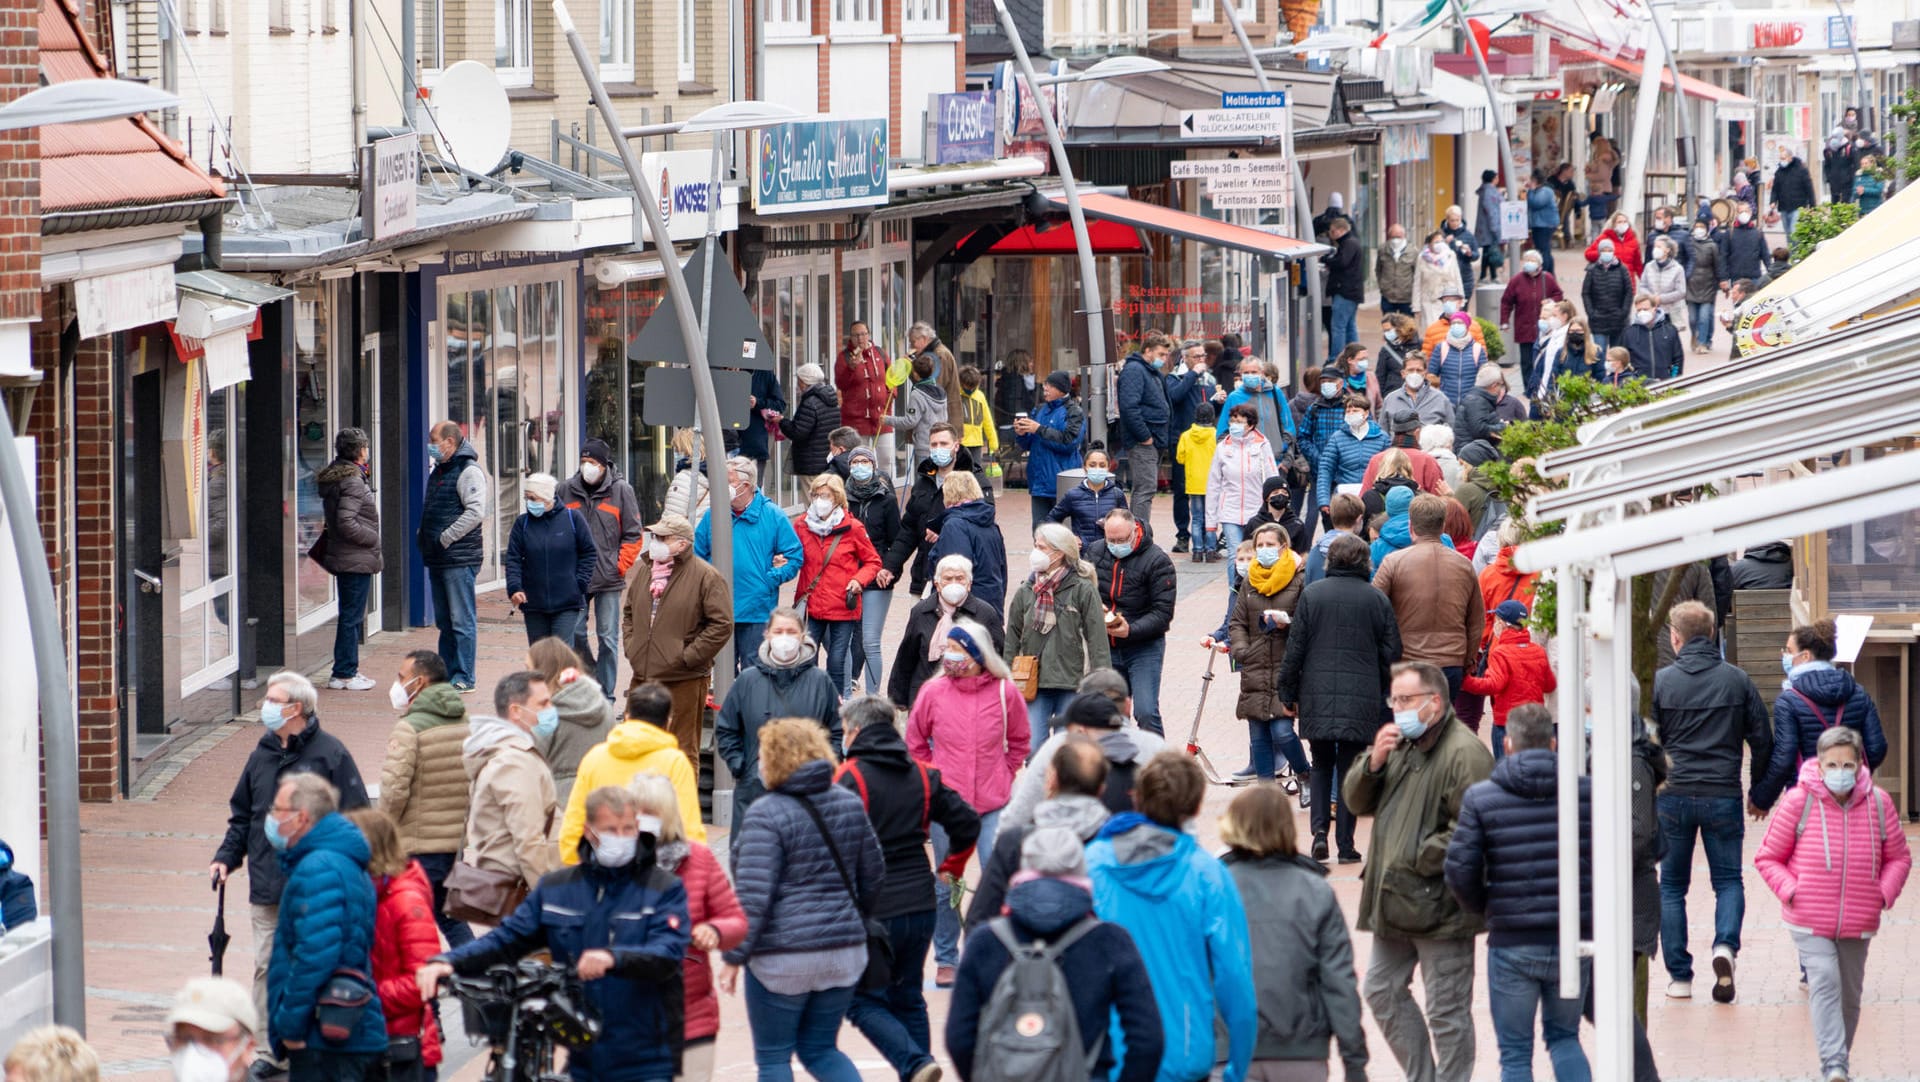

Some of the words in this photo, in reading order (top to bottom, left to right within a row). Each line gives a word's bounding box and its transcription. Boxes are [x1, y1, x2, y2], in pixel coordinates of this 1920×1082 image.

[1225, 95, 1281, 106] Moltkestraße
[947, 95, 986, 142] CLASSIC
[1208, 112, 1271, 121] WOLL-ATELIER
[779, 131, 821, 190] Gemälde
[828, 128, 867, 179] Albrecht
[1172, 163, 1191, 175] Café
[1194, 164, 1219, 174] Bohne
[1248, 162, 1286, 173] Seemeile
[1213, 179, 1248, 189] Juwelier
[1252, 178, 1281, 187] Kremin
[674, 183, 707, 213] NORDSEE
[1218, 194, 1257, 205] Fantomas
[1261, 194, 1281, 204] 2000
[1128, 284, 1203, 297] Restaurant
